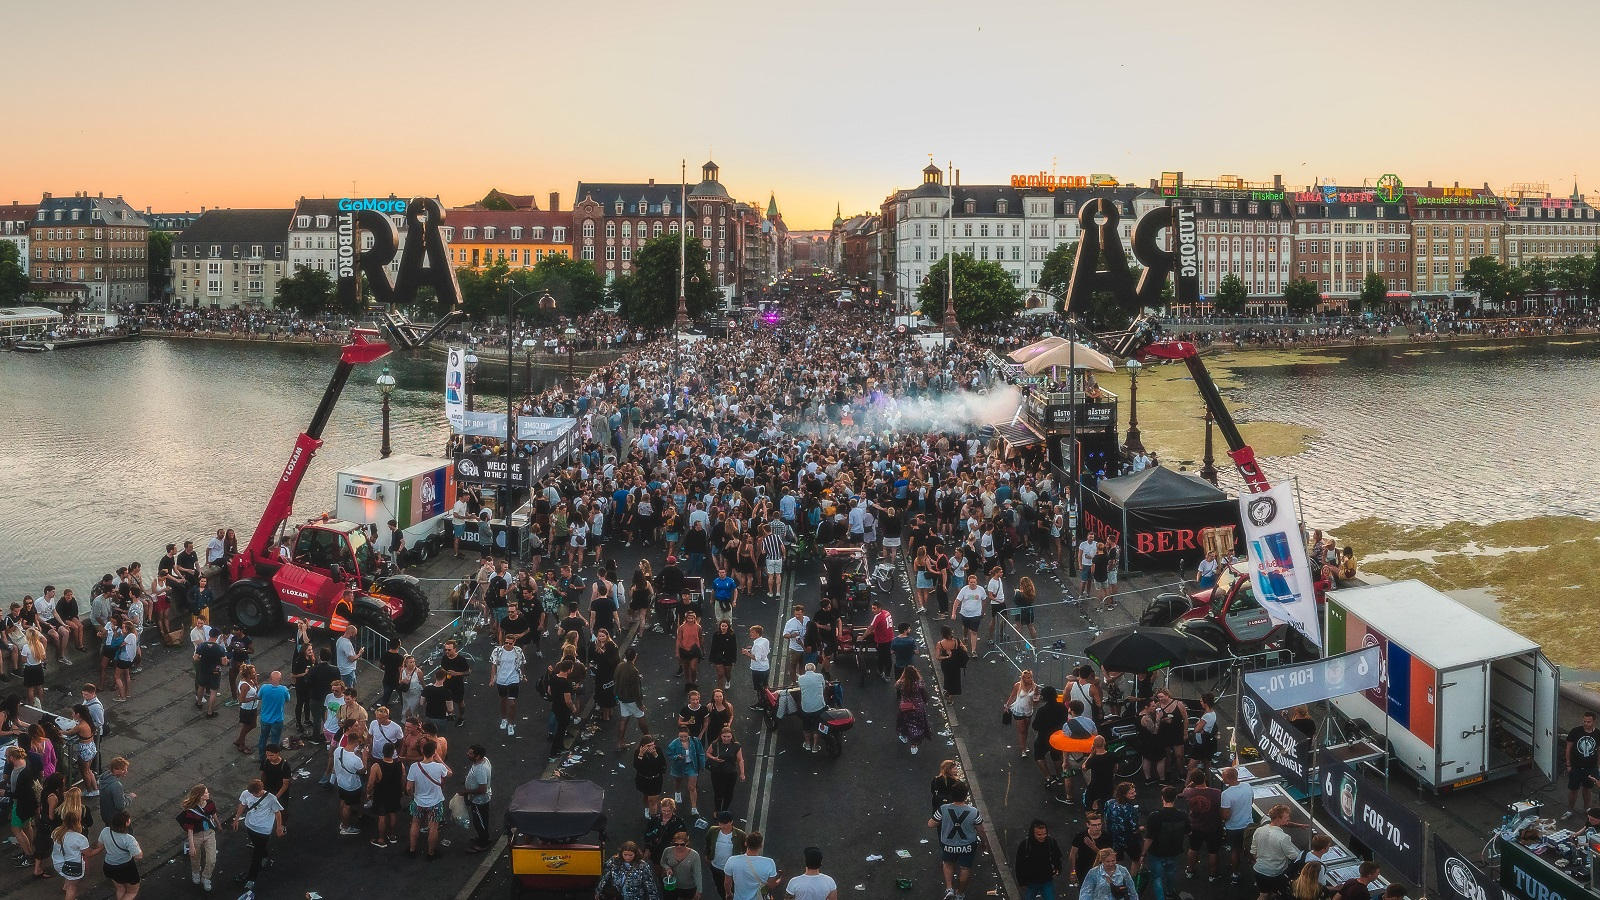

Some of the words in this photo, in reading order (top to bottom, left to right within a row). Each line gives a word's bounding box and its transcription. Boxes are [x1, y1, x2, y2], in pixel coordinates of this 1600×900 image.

[338, 198, 406, 212] GoMore
[338, 213, 354, 278] TUBORG
[285, 446, 303, 476] LOXAM
[486, 461, 521, 473] WELCME
[484, 470, 491, 478] TO
[492, 471, 502, 479] THE
[502, 473, 523, 481] JGLE
[1136, 525, 1238, 554] BER
[286, 589, 308, 598] LOXAM
[1258, 734, 1270, 751] TO
[1325, 771, 1333, 797] 6
[1363, 803, 1384, 836] FOR
[1386, 821, 1410, 852] 70,-
[943, 844, 973, 854] ADIDAS
